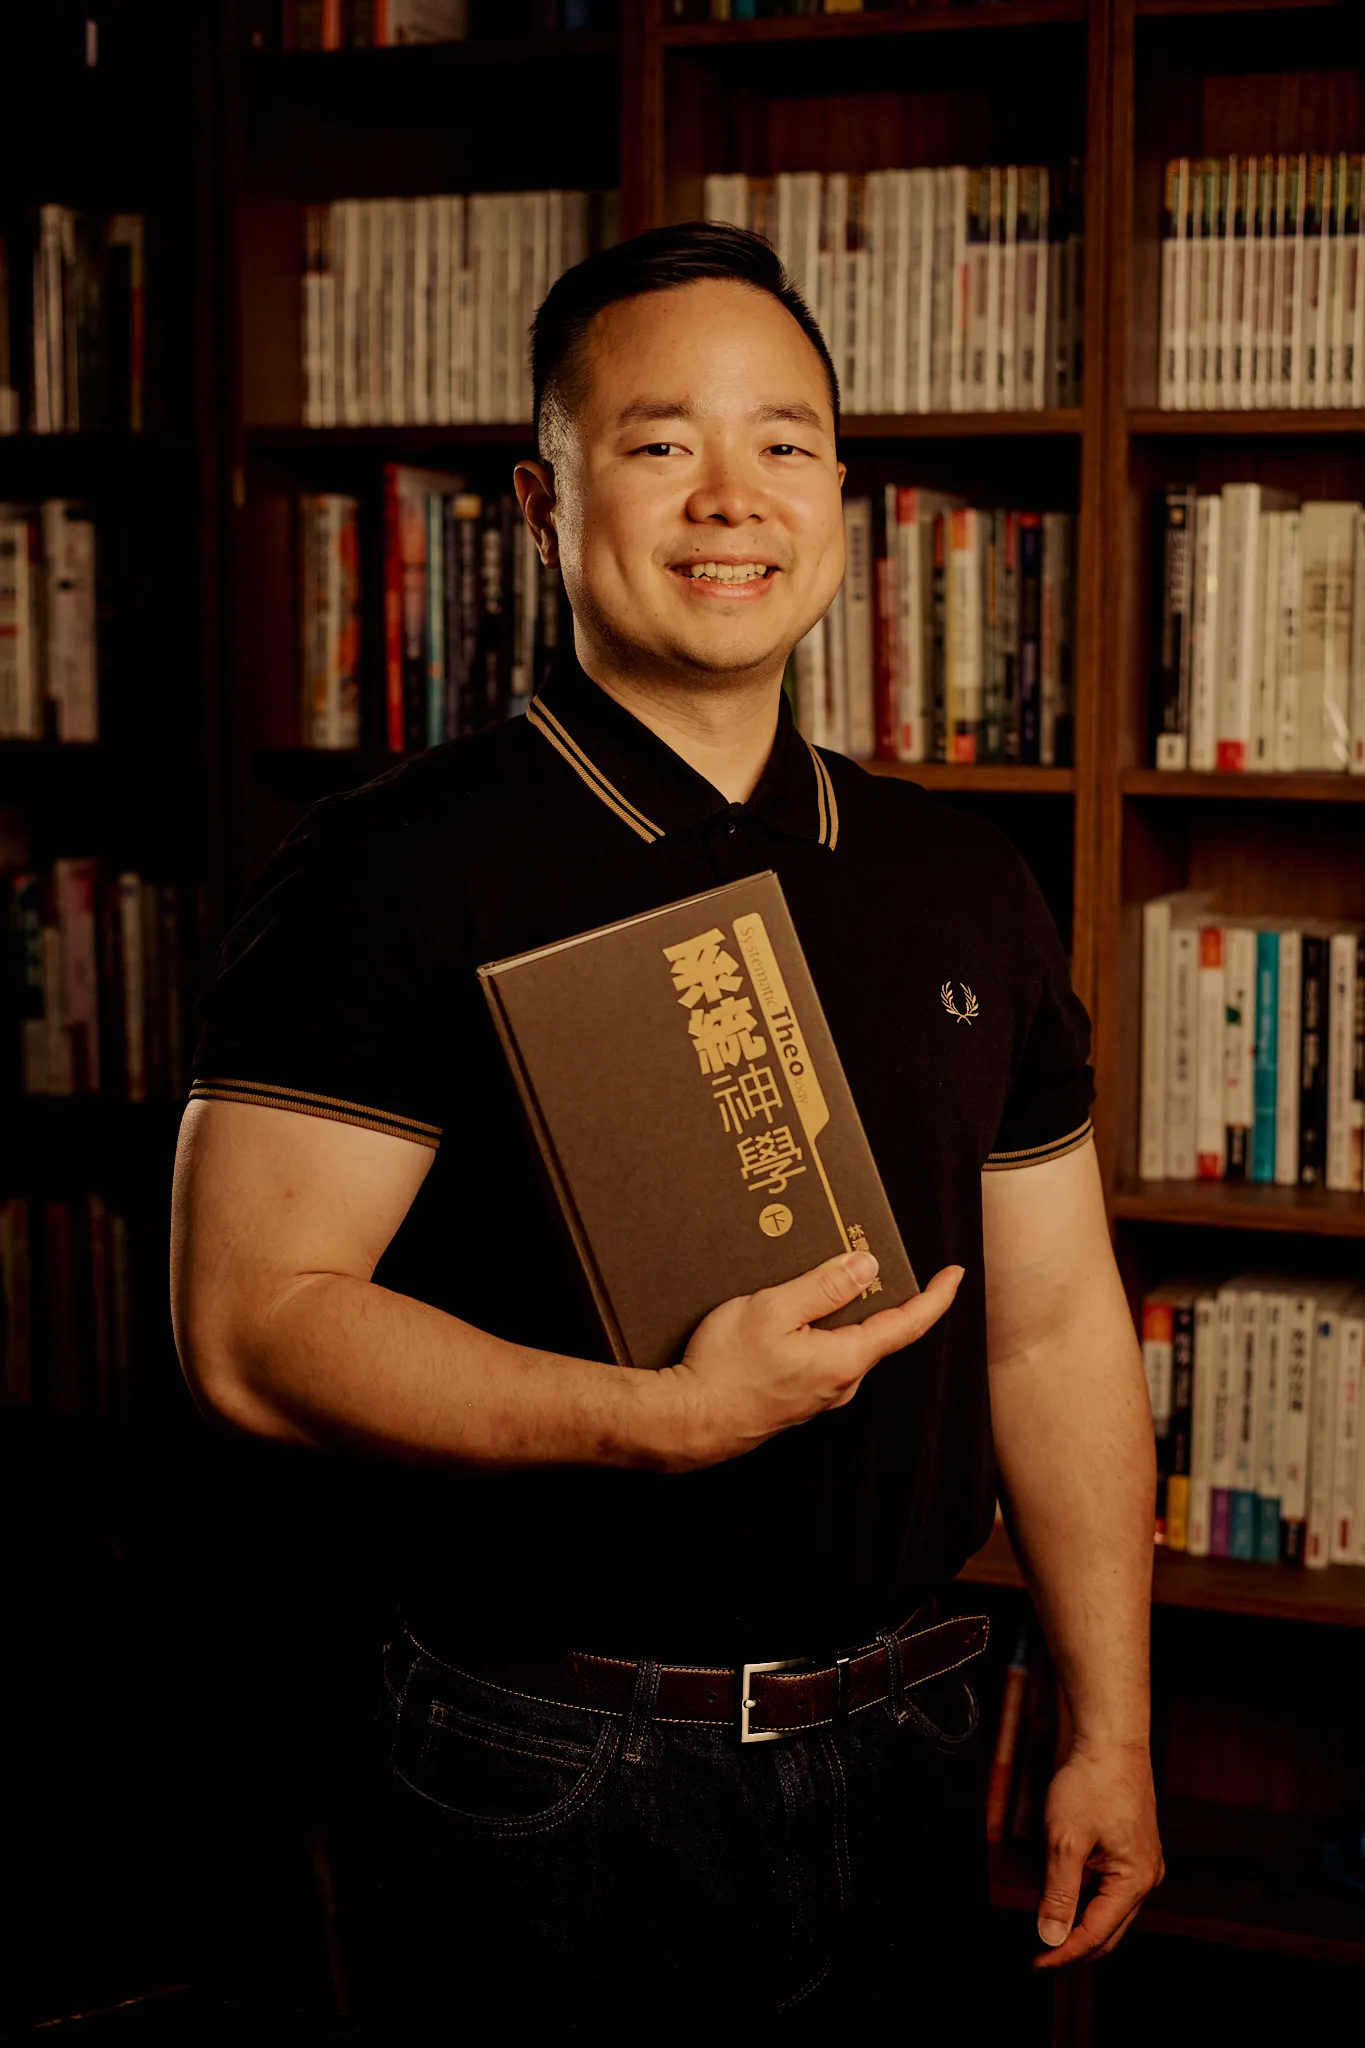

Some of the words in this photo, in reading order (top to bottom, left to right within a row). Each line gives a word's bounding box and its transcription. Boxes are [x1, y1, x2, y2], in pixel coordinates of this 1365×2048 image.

[662, 927, 807, 1194] 系統神學
[740, 926, 778, 1007] Systematic
[771, 1005, 809, 1105] Theology
